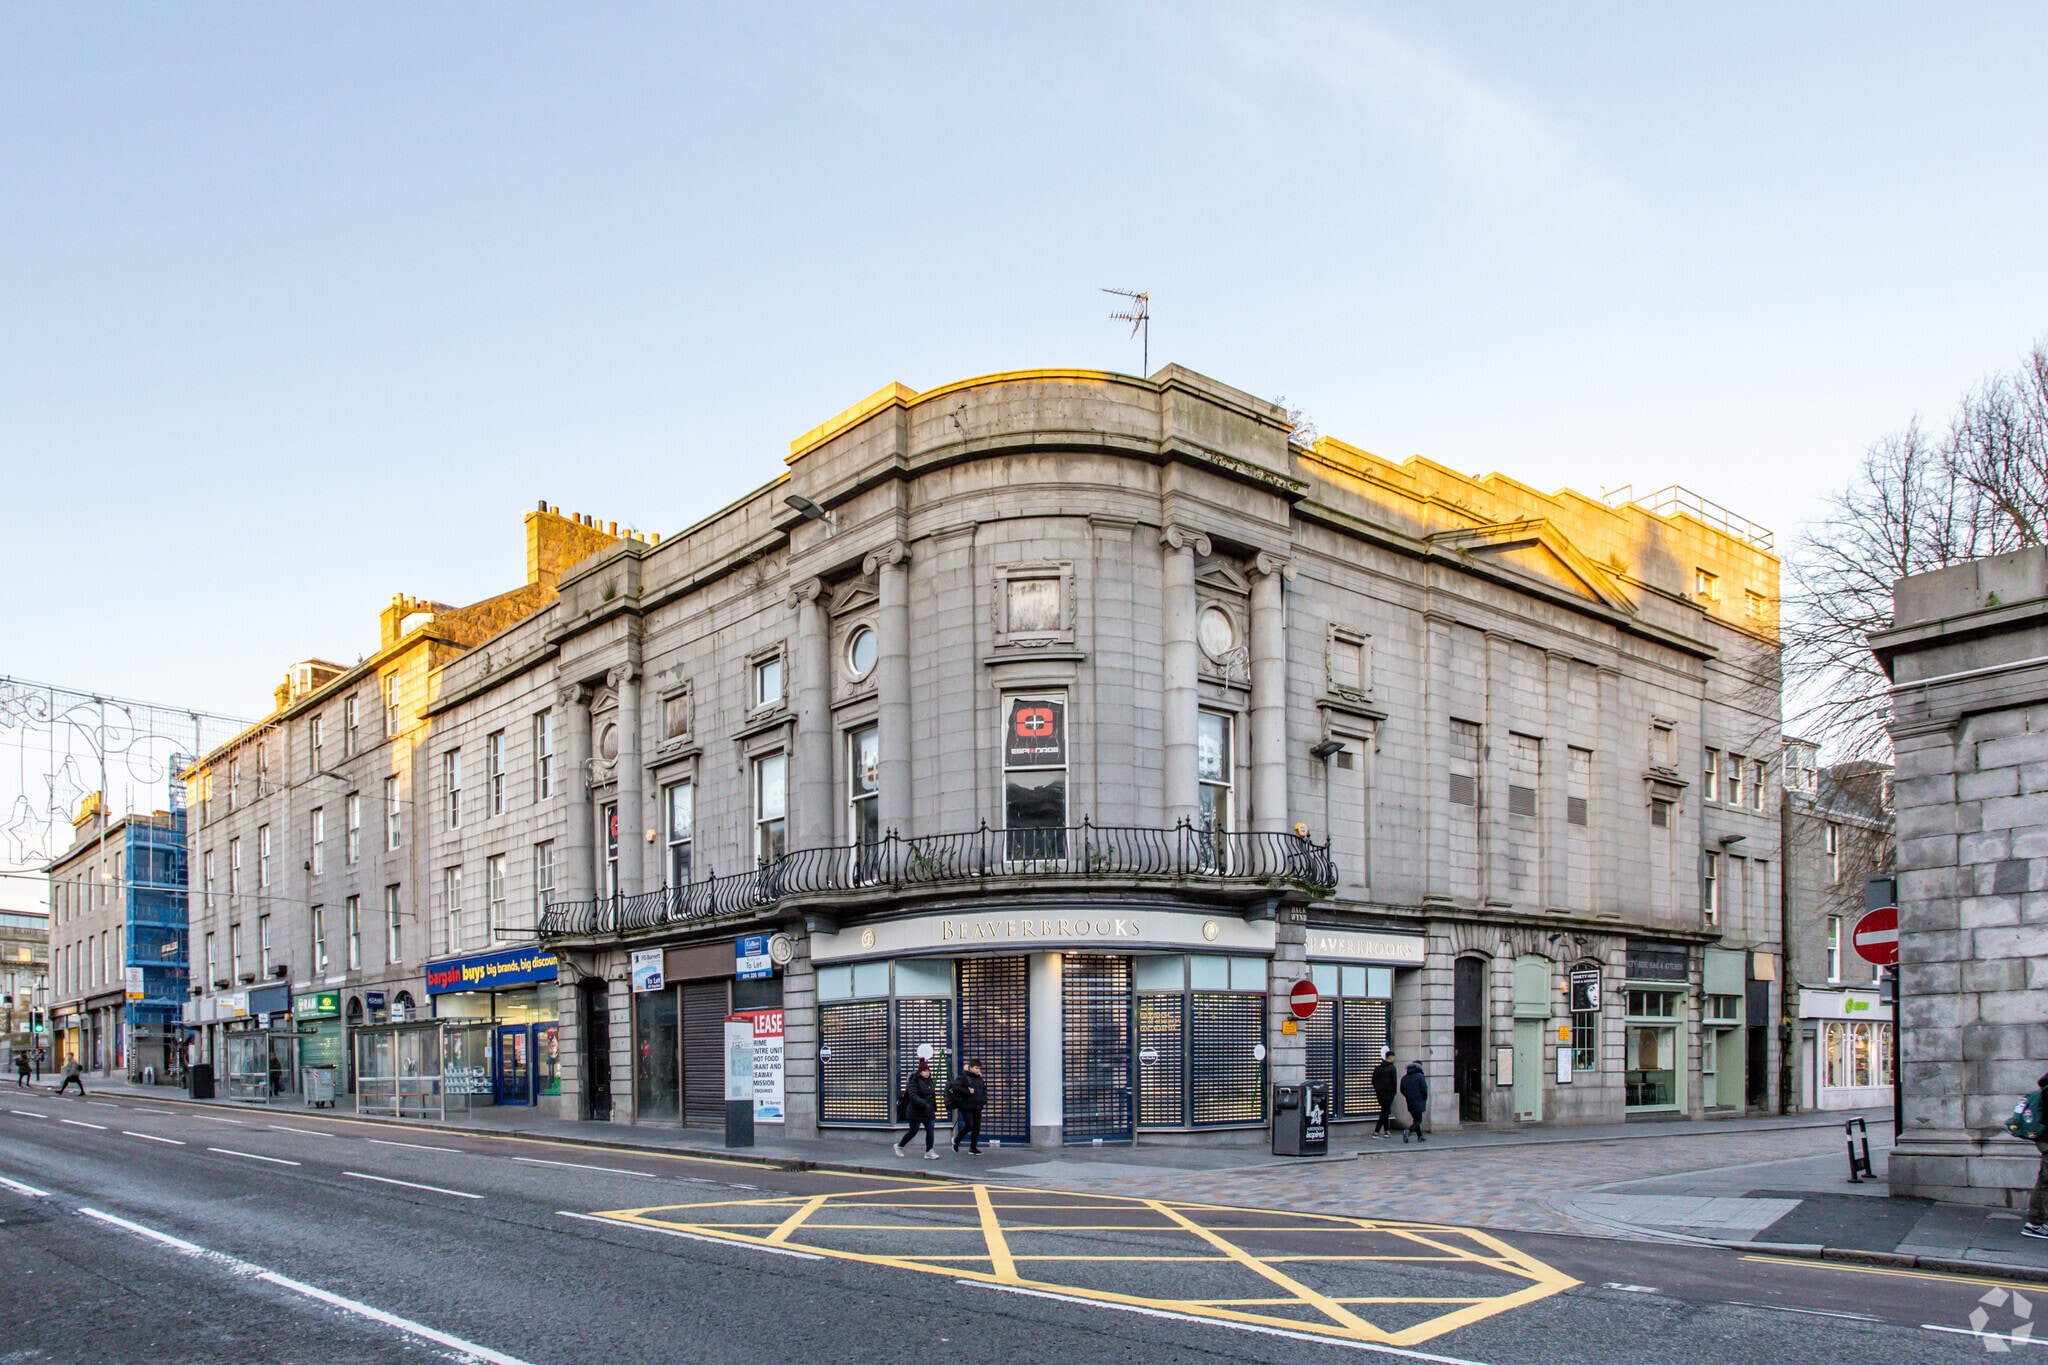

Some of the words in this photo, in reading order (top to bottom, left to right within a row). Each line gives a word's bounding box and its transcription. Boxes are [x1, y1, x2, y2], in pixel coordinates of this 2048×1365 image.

[941, 919, 1140, 940] BEAVERBROOKS
[428, 965, 461, 988] bargain
[462, 964, 485, 984] buys
[486, 963, 497, 977] big
[497, 960, 520, 973] brands,
[520, 958, 531, 972] big
[754, 1013, 783, 1034] LEASE
